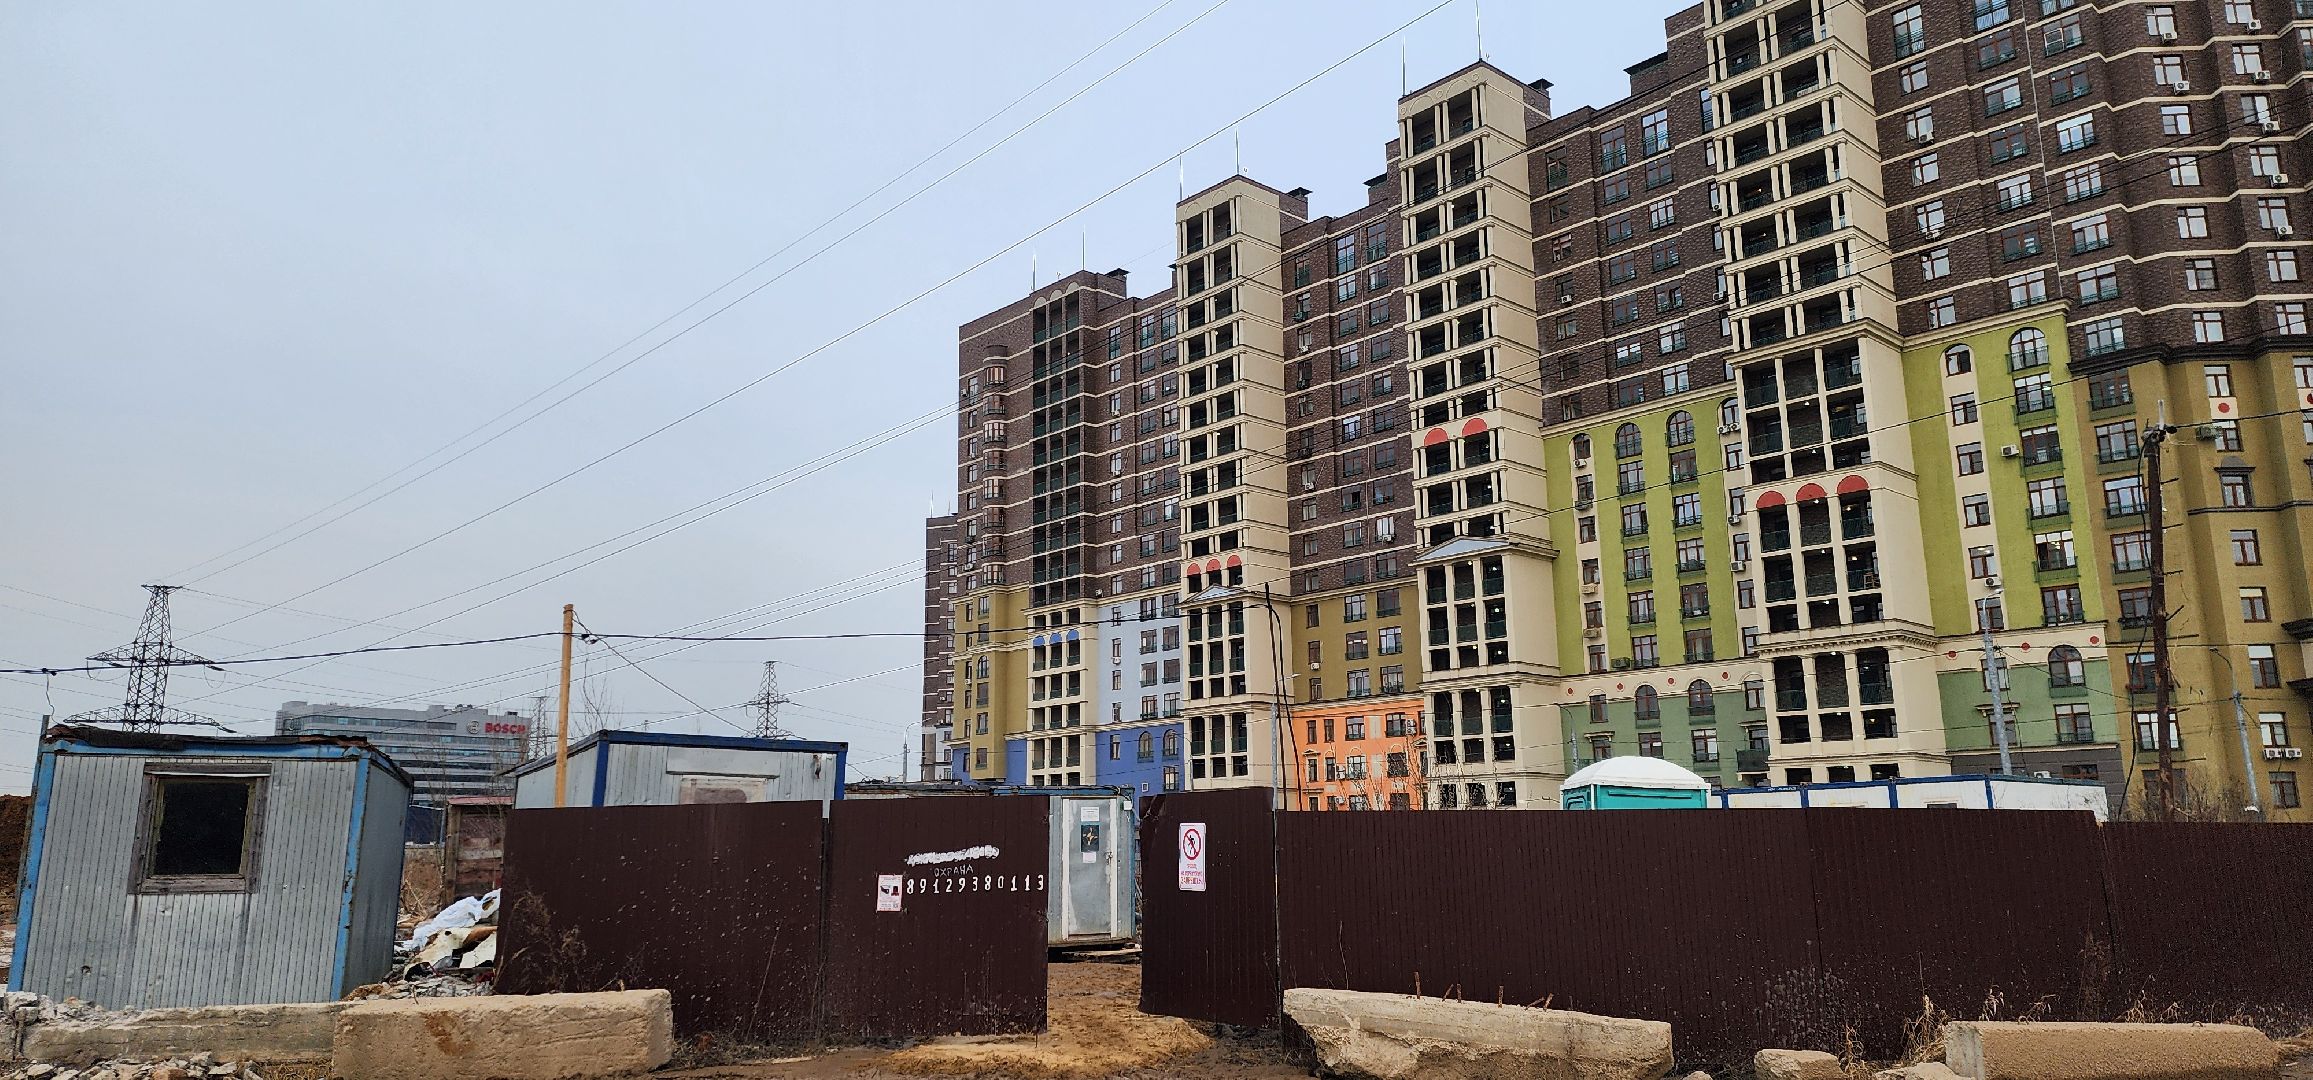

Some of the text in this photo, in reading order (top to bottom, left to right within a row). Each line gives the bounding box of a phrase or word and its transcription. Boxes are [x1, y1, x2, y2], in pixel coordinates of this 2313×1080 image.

[484, 722, 526, 734] BOSCH
[934, 864, 974, 877] ОХРАНА
[906, 874, 1044, 894] 89129380113
